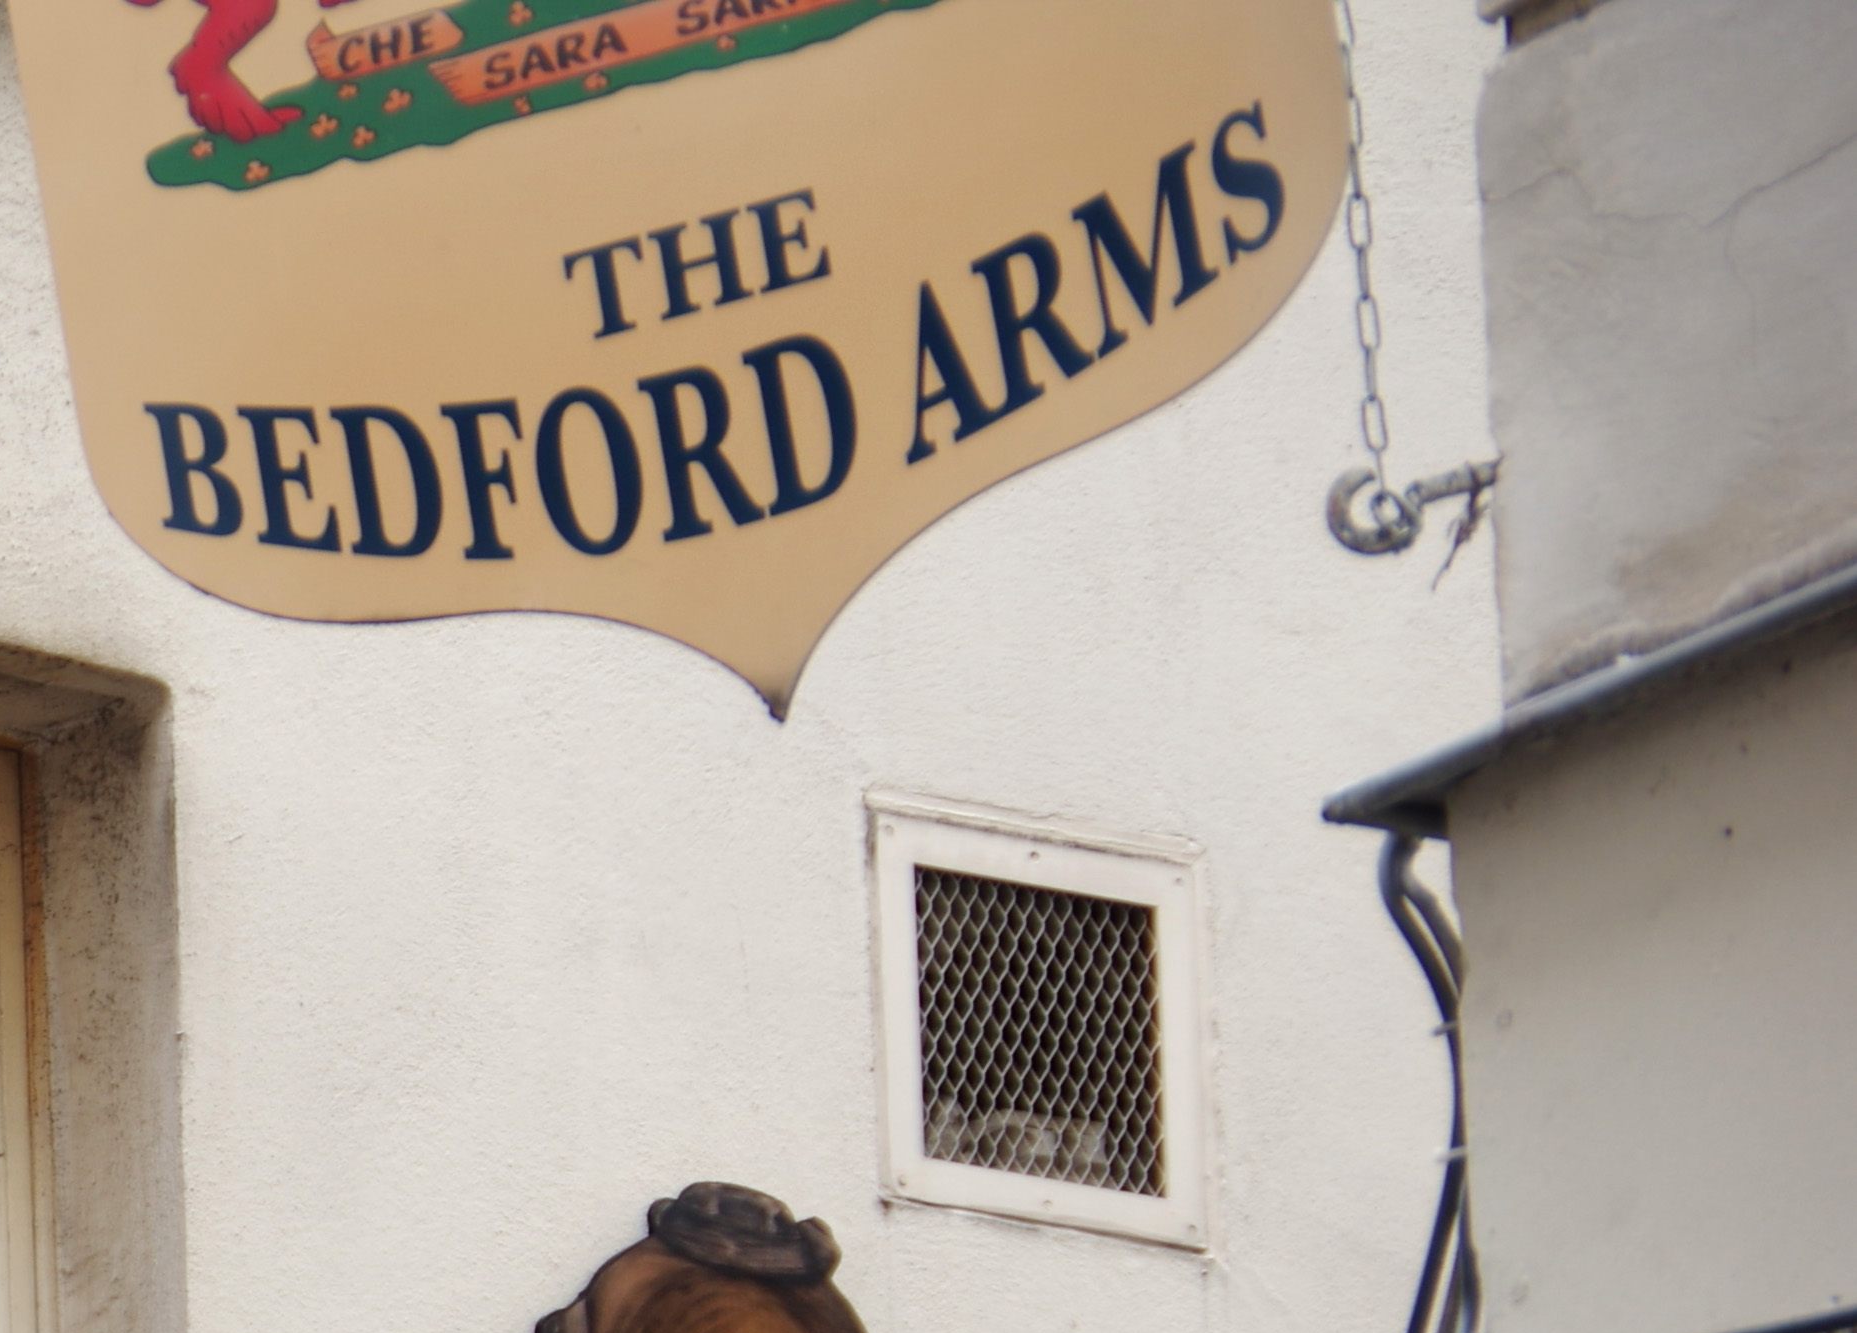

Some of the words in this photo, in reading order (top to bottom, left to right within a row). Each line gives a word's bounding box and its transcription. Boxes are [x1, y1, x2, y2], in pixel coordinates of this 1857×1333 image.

[337, 14, 437, 74] CHE
[485, 22, 628, 91] SARA
[562, 189, 834, 340] THE
[143, 333, 859, 561] BEDFORD
[903, 101, 1288, 466] ARMS
